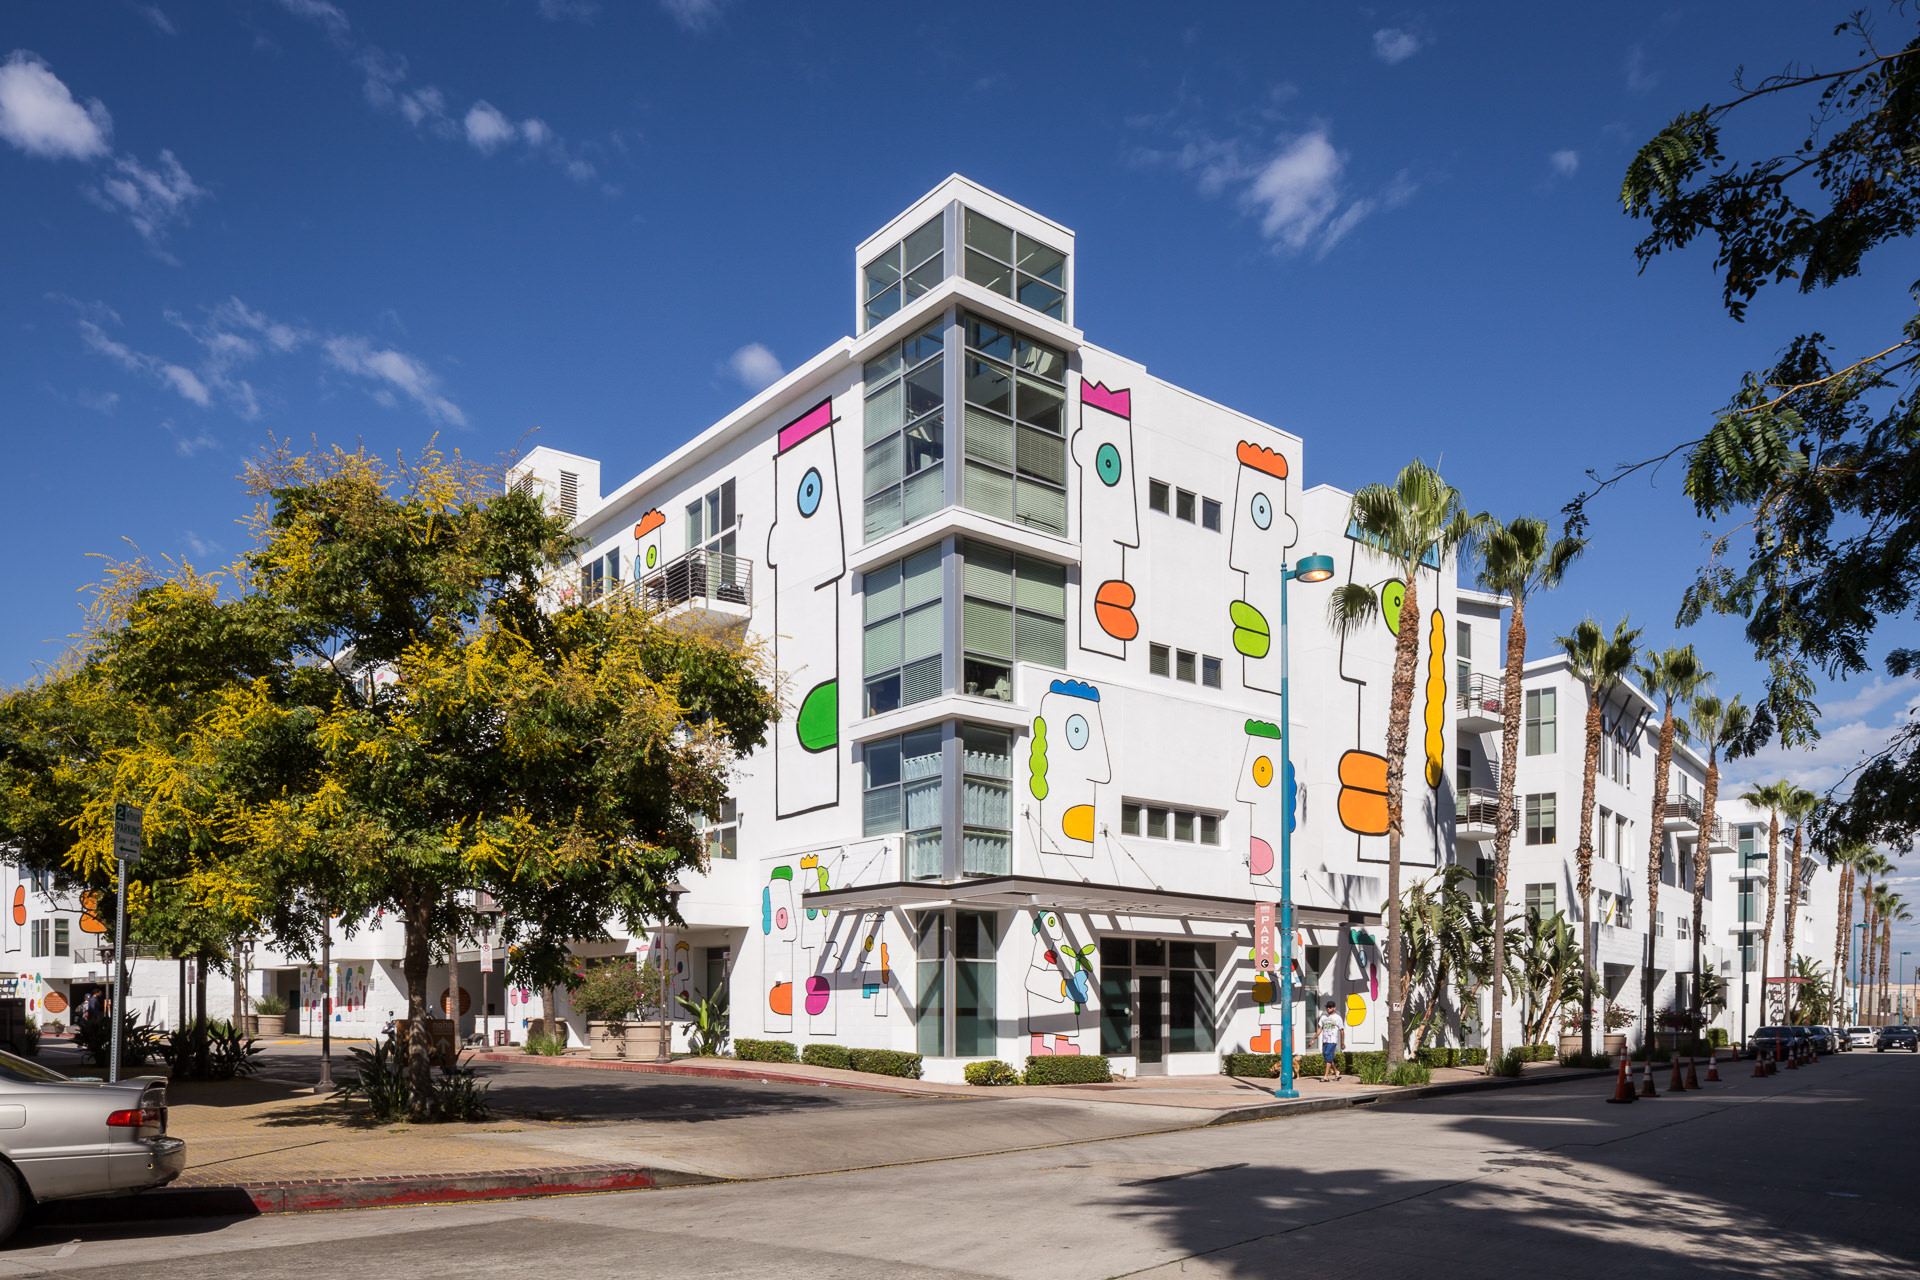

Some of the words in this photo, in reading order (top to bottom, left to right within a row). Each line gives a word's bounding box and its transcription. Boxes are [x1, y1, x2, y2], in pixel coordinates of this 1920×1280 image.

[117, 806, 125, 819] 2
[126, 811, 140, 823] HOUR
[116, 821, 141, 837] PARKING
[1260, 915, 1270, 956] PARK
